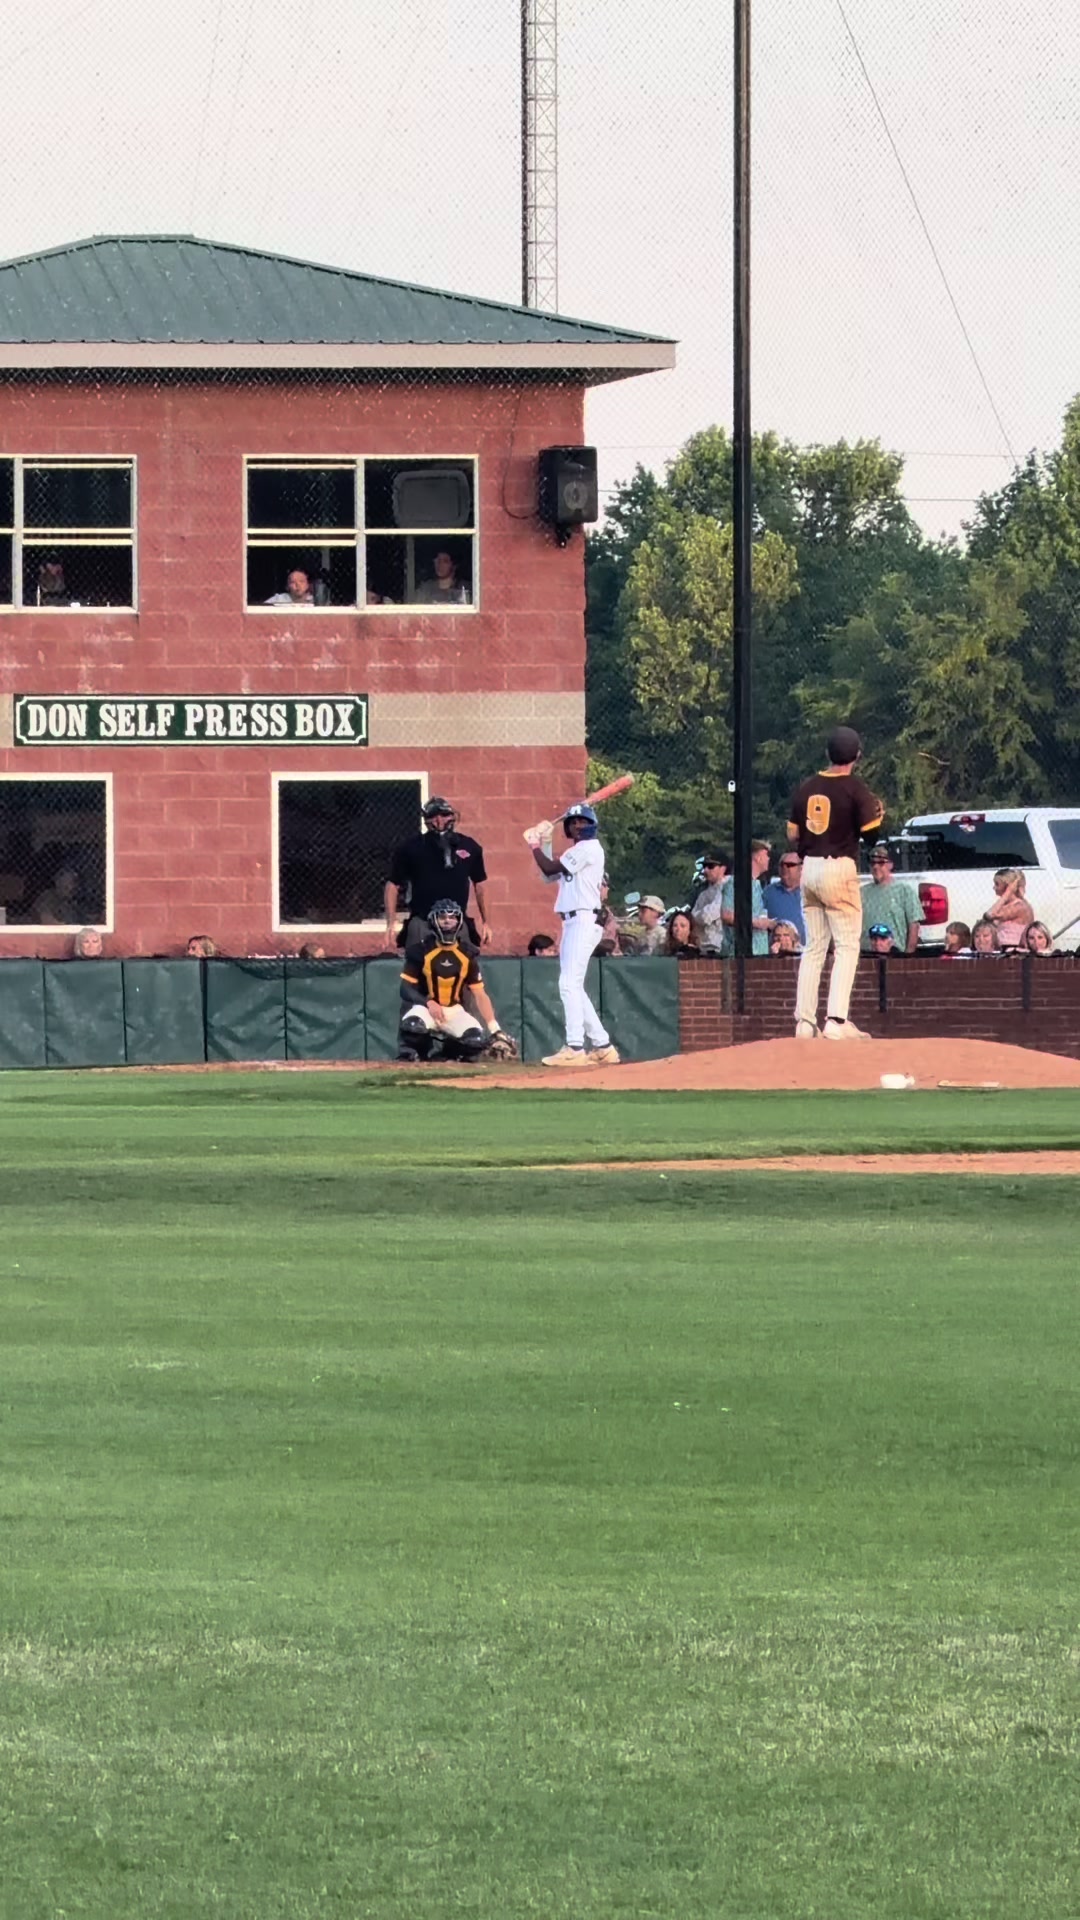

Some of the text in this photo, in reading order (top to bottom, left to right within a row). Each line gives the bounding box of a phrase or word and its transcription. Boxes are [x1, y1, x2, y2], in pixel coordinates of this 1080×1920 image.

[27, 704, 355, 737] DON SELF PRESS BOX
[806, 794, 831, 835] 9
